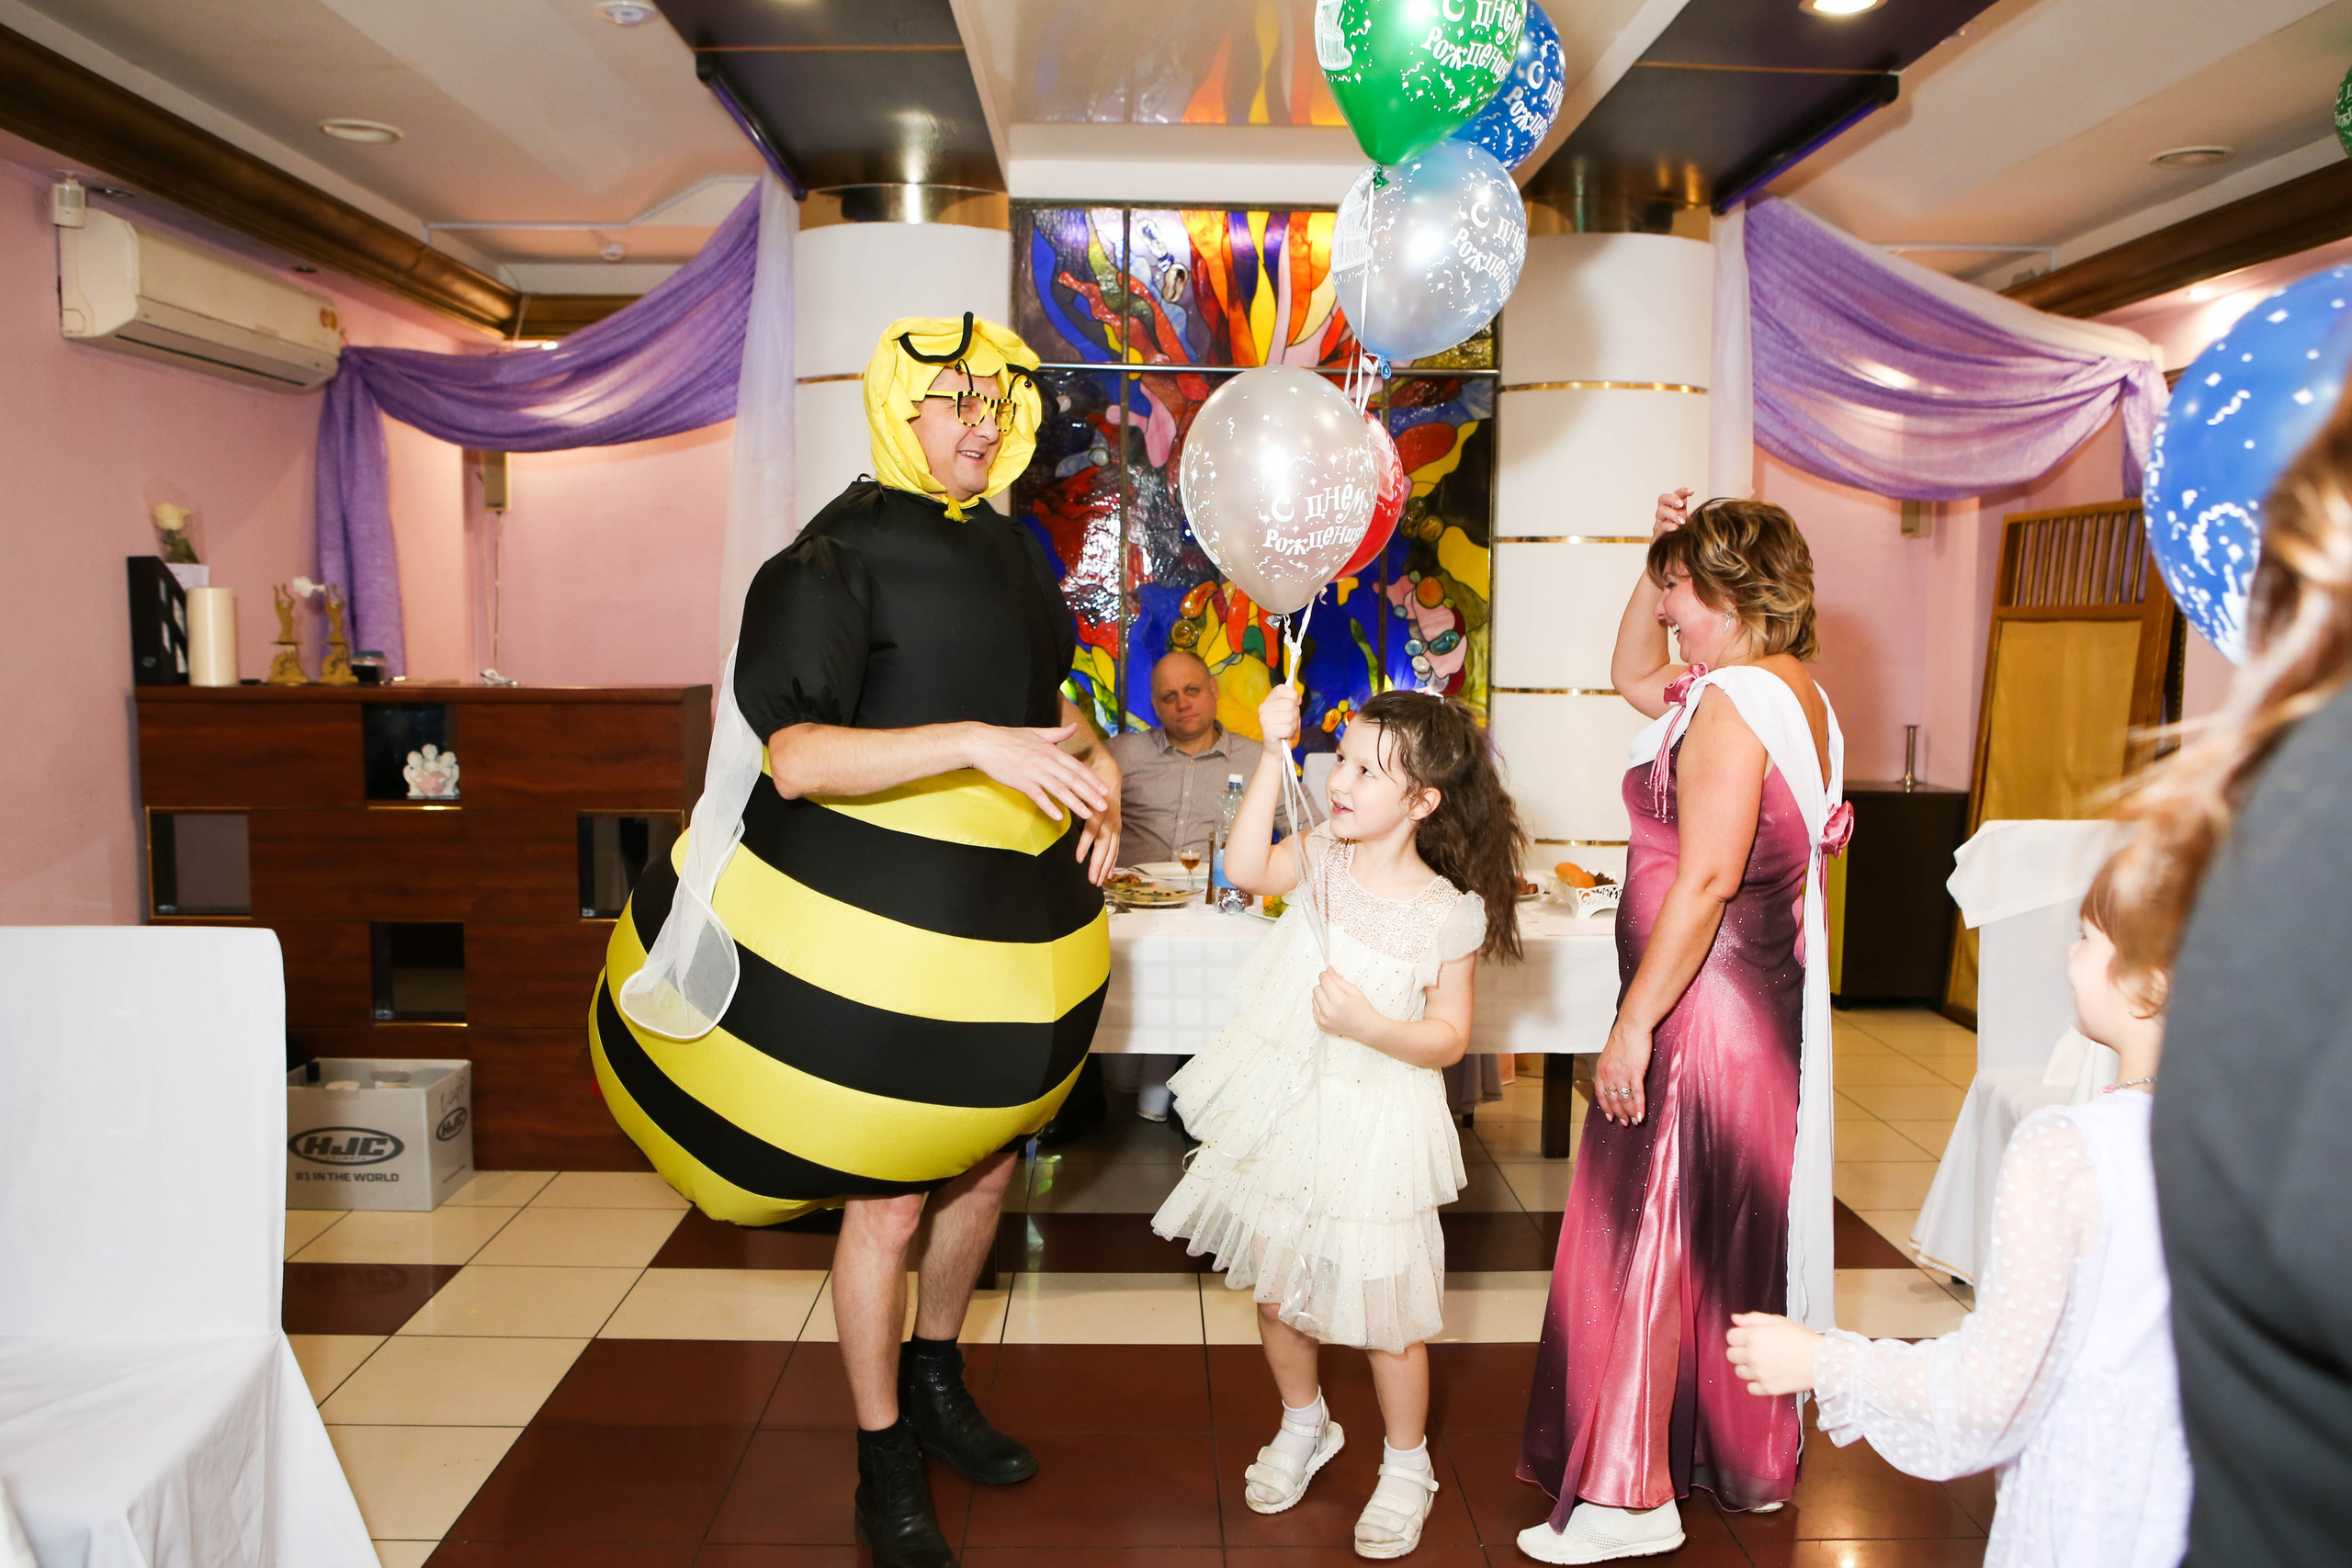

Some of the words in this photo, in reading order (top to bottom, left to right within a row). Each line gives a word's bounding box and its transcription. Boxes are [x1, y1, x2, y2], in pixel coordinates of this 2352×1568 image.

[1471, 201, 1490, 229] С
[1271, 496, 1295, 523] С
[303, 1136, 389, 1156] HJC
[312, 1172, 325, 1182] IN
[327, 1172, 351, 1182] THE
[353, 1172, 400, 1183] WORLD
